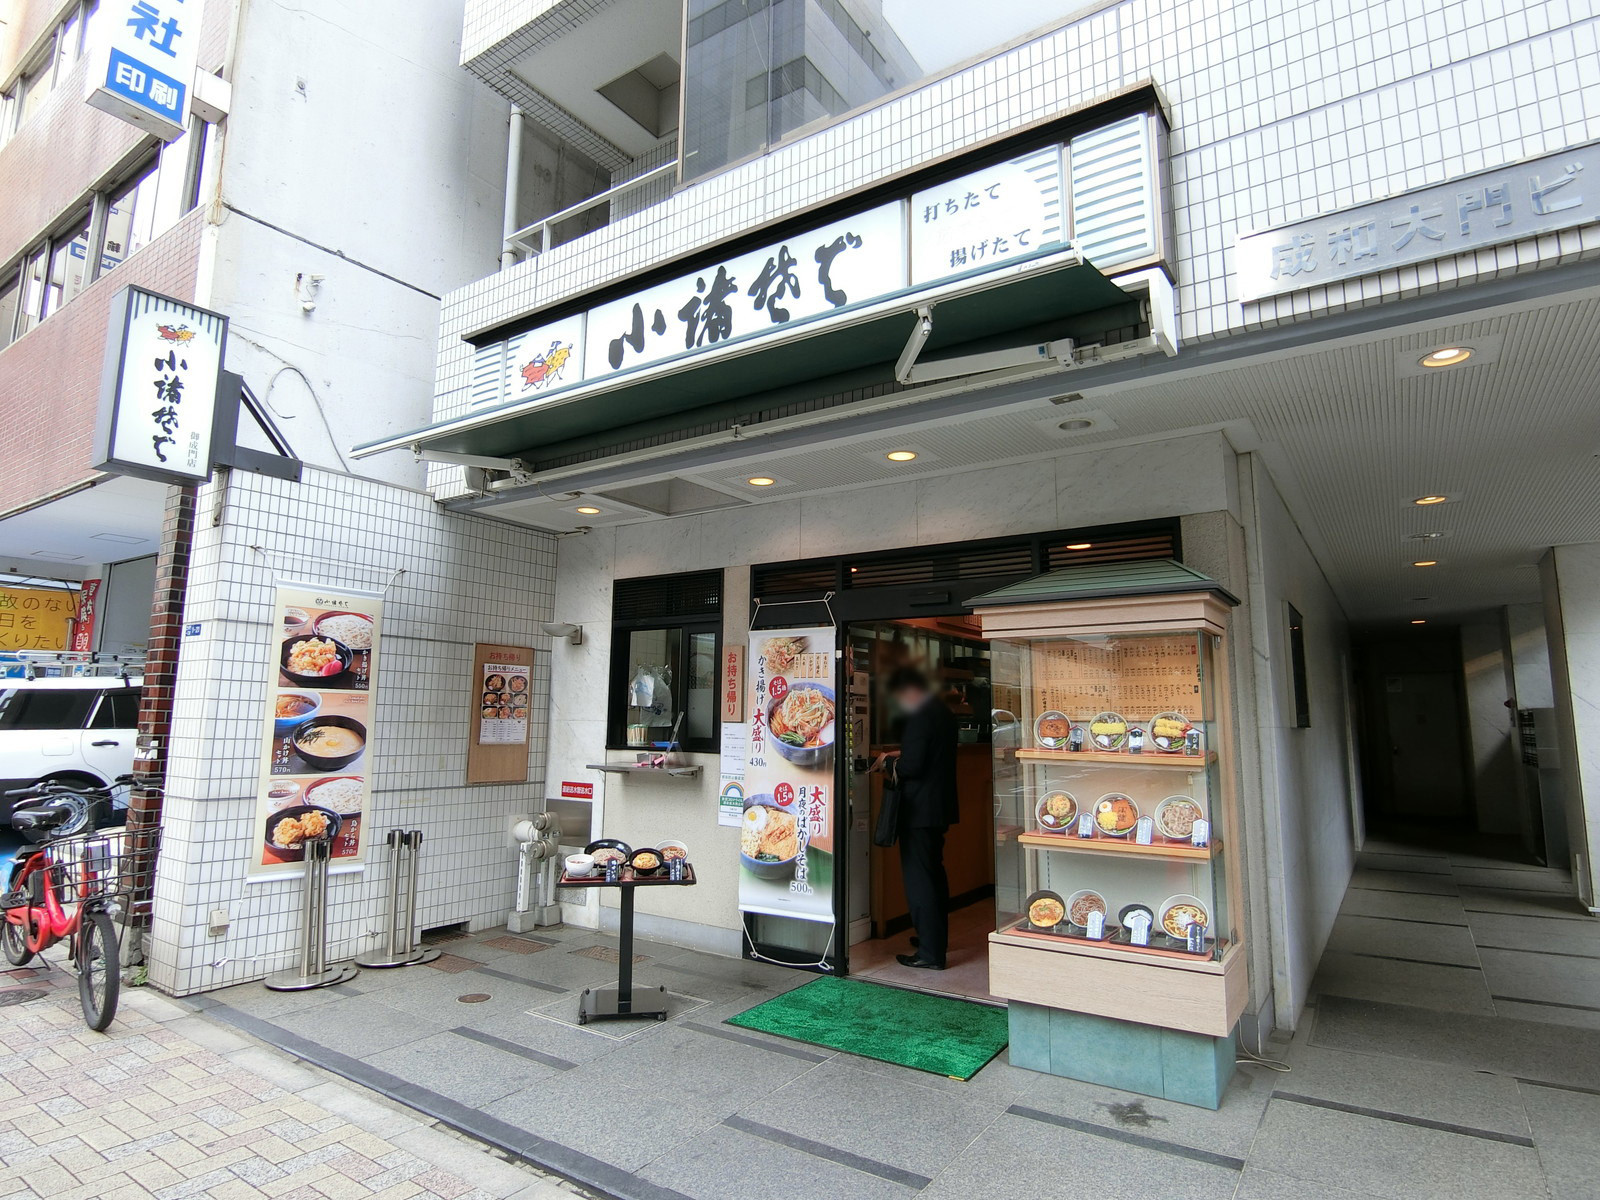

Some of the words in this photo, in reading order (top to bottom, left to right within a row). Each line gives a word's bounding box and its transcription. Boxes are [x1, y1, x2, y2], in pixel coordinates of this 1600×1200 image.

[126, 0, 184, 58] 社
[115, 61, 178, 111] 印刷
[924, 182, 1001, 223] 打ちたて
[1270, 162, 1585, 281] 成和大門ビ
[949, 228, 1031, 268] 揚げたて
[186, 431, 200, 468] 御成門店
[361, 649, 369, 681] かき揚げ丼
[489, 652, 521, 661] お持ち帰り
[726, 652, 738, 716] お持ち帰り
[755, 655, 767, 705] かき揚げ
[281, 737, 292, 764] 山かけ丼
[752, 709, 766, 753] 大盛り
[750, 757, 767, 768] 430円
[808, 786, 826, 835] 大盛り
[796, 786, 809, 880] 月夜のばかしそば
[791, 882, 813, 894] 500円
